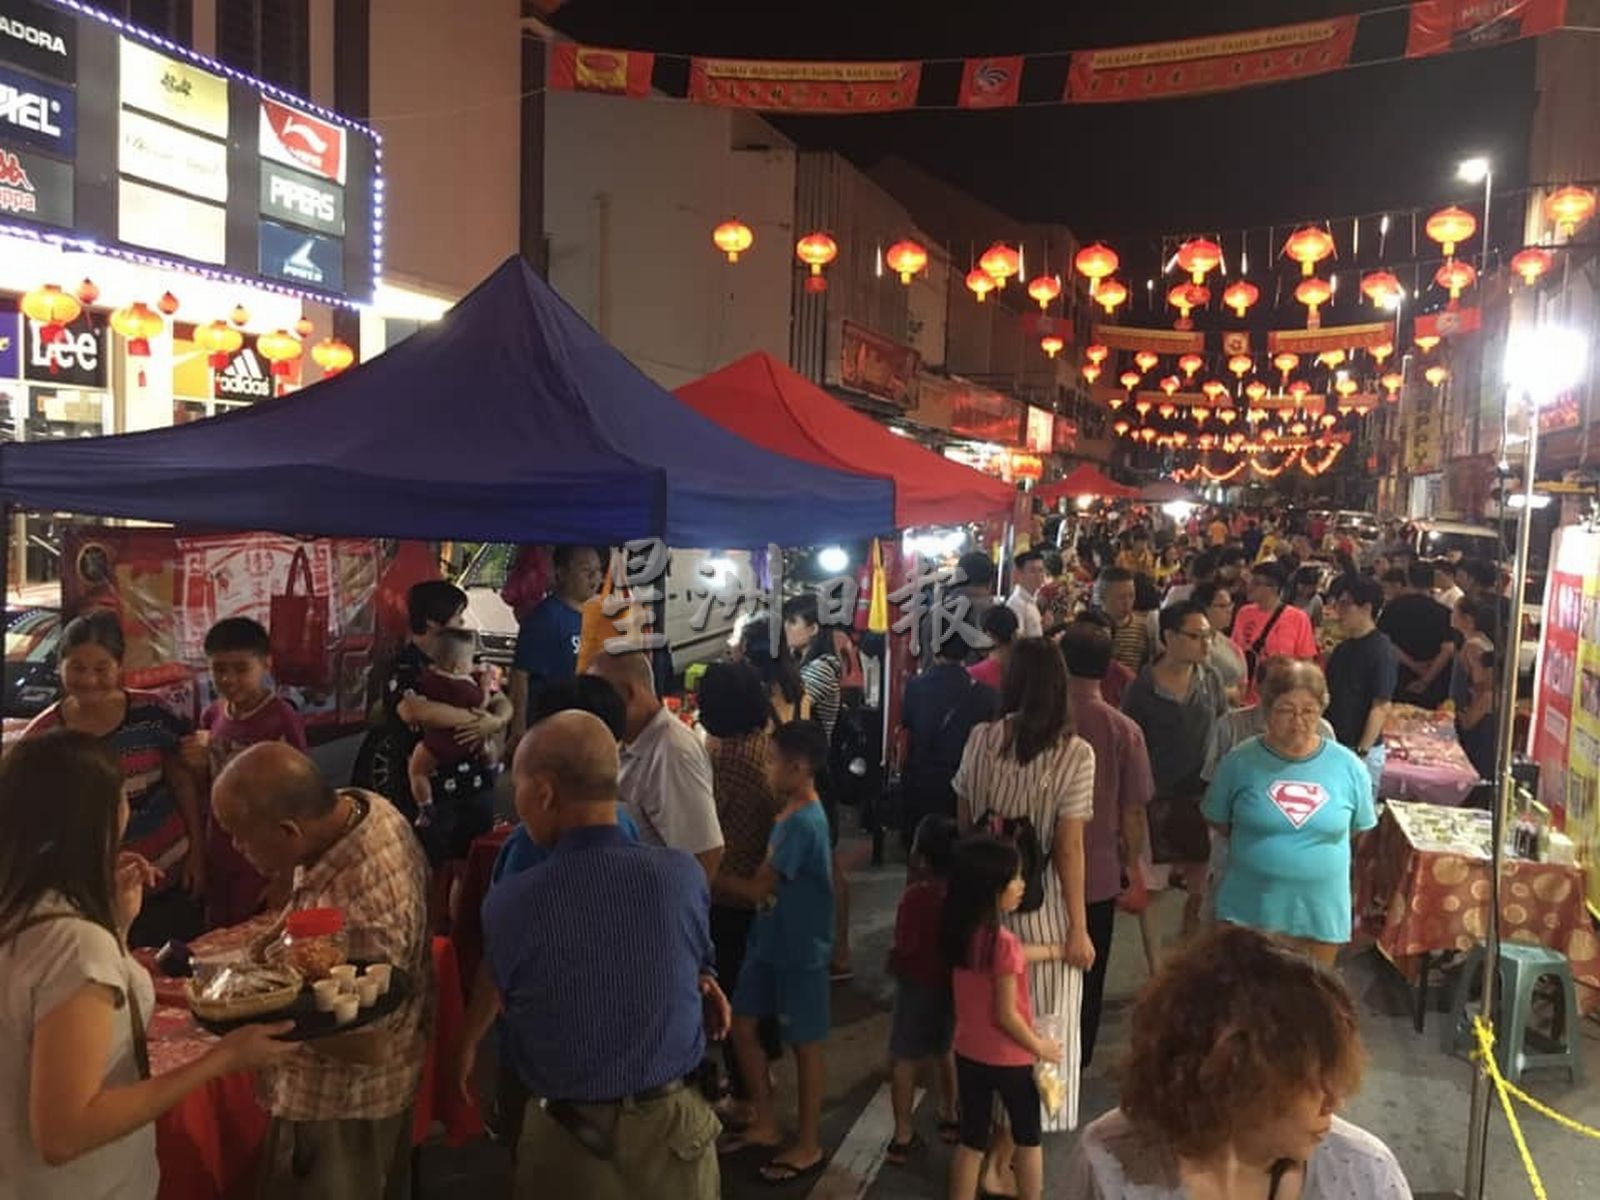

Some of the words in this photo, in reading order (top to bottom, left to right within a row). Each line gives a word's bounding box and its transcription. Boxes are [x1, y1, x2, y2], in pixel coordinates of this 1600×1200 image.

[270, 174, 335, 221] PIPERS
[30, 318, 98, 371] Lee
[220, 374, 269, 396] adidas
